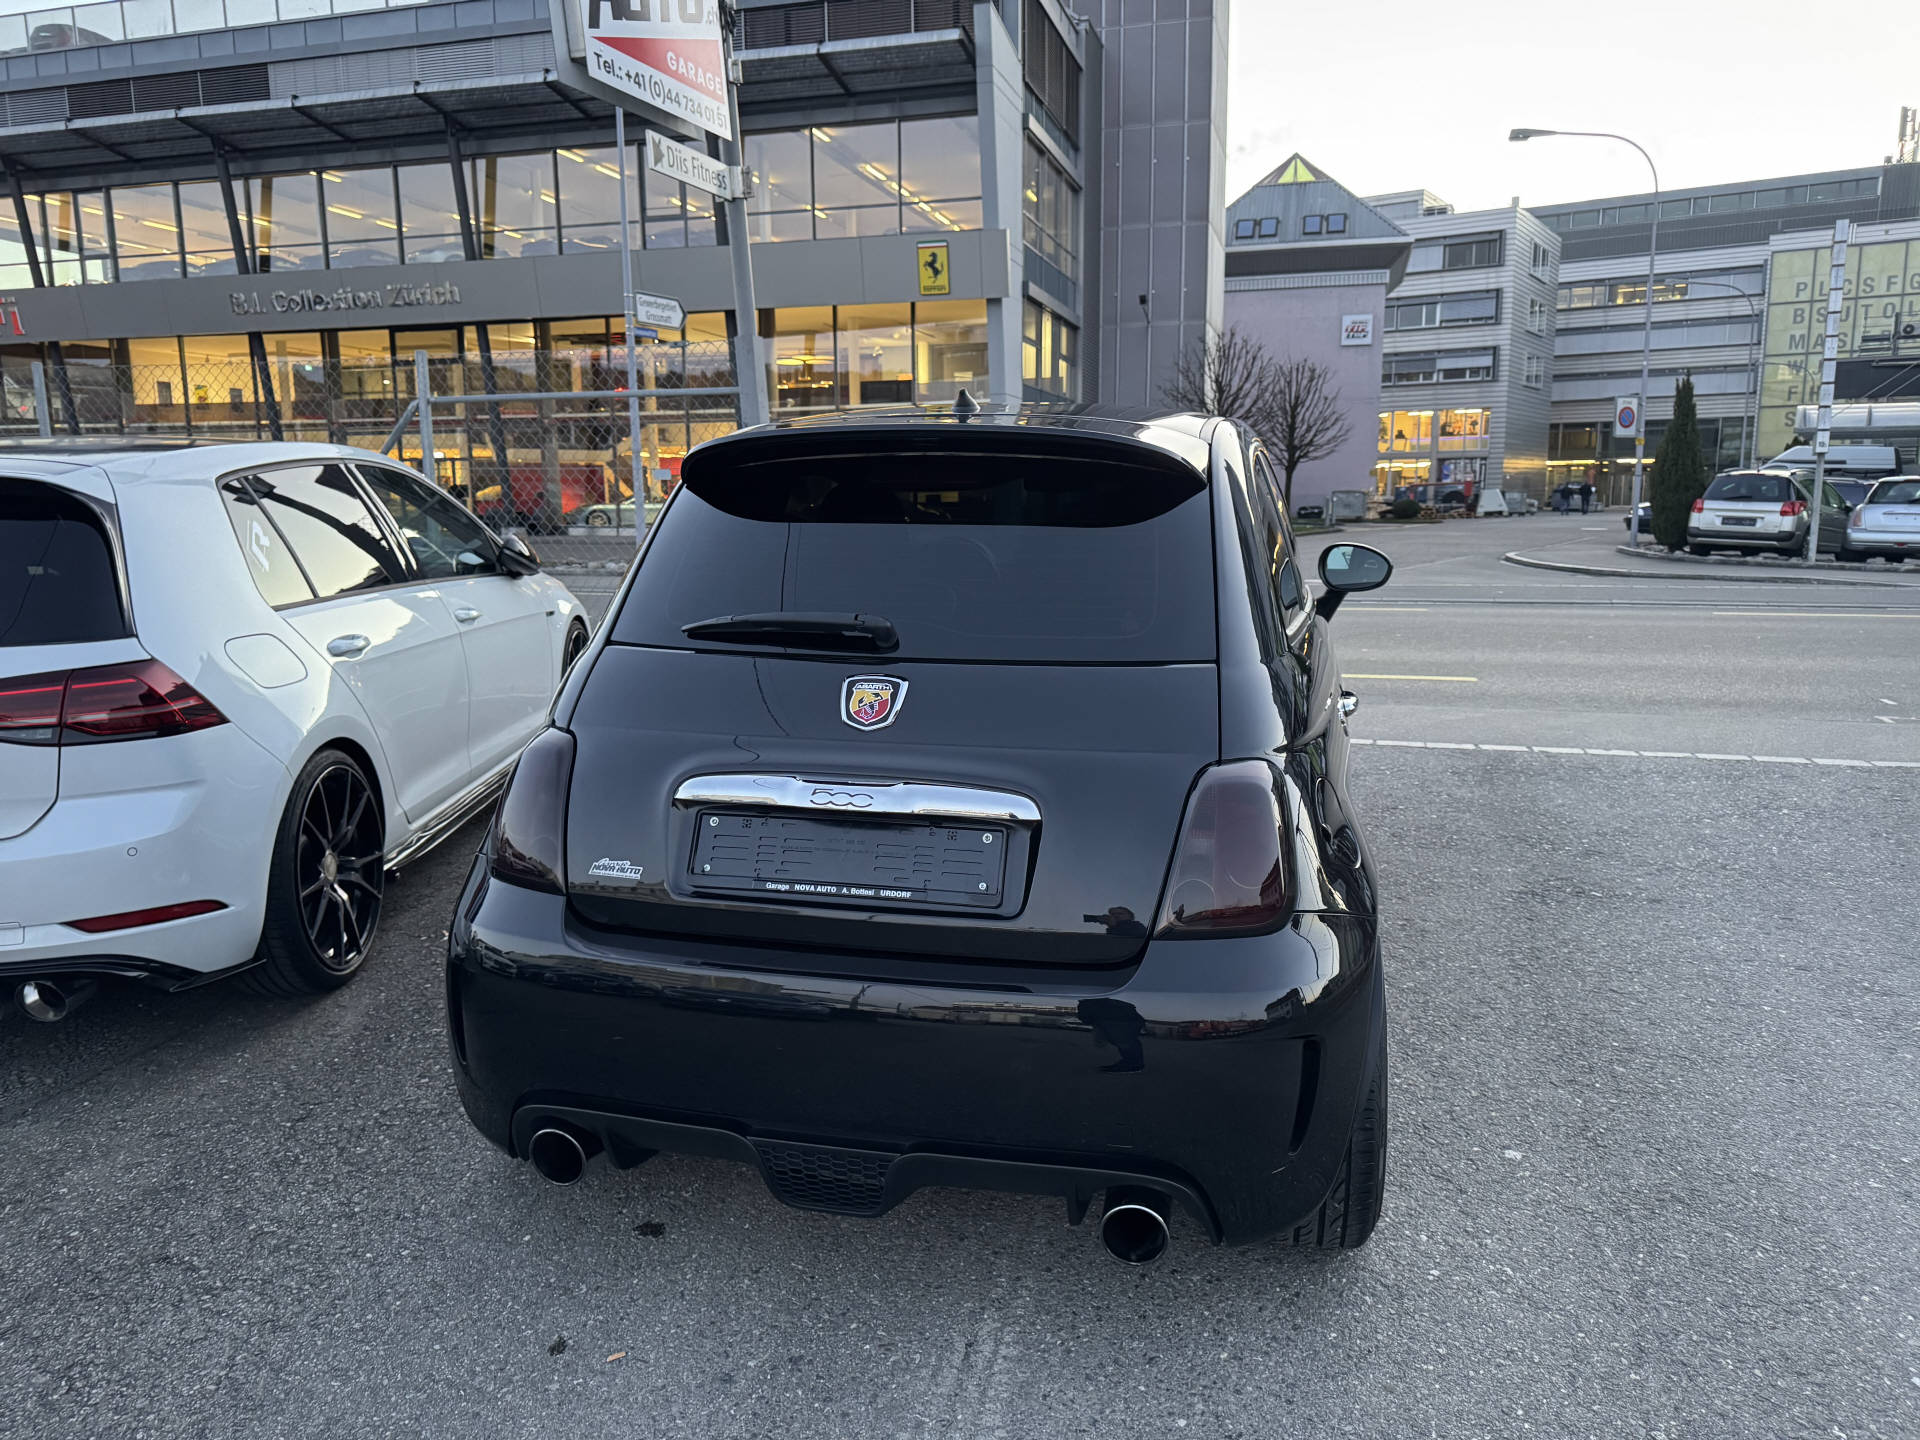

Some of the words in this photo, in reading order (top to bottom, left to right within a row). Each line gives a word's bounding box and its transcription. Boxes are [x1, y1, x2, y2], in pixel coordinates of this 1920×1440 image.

[666, 51, 723, 95] GARAGE
[691, 157, 728, 190] Fitness
[271, 286, 383, 313] Collection
[386, 280, 462, 307] Zürich
[809, 788, 874, 808] 500
[765, 882, 790, 891] Garage
[794, 884, 815, 892] NOVA
[816, 885, 837, 893] AUTO
[880, 889, 912, 898] URDORF
